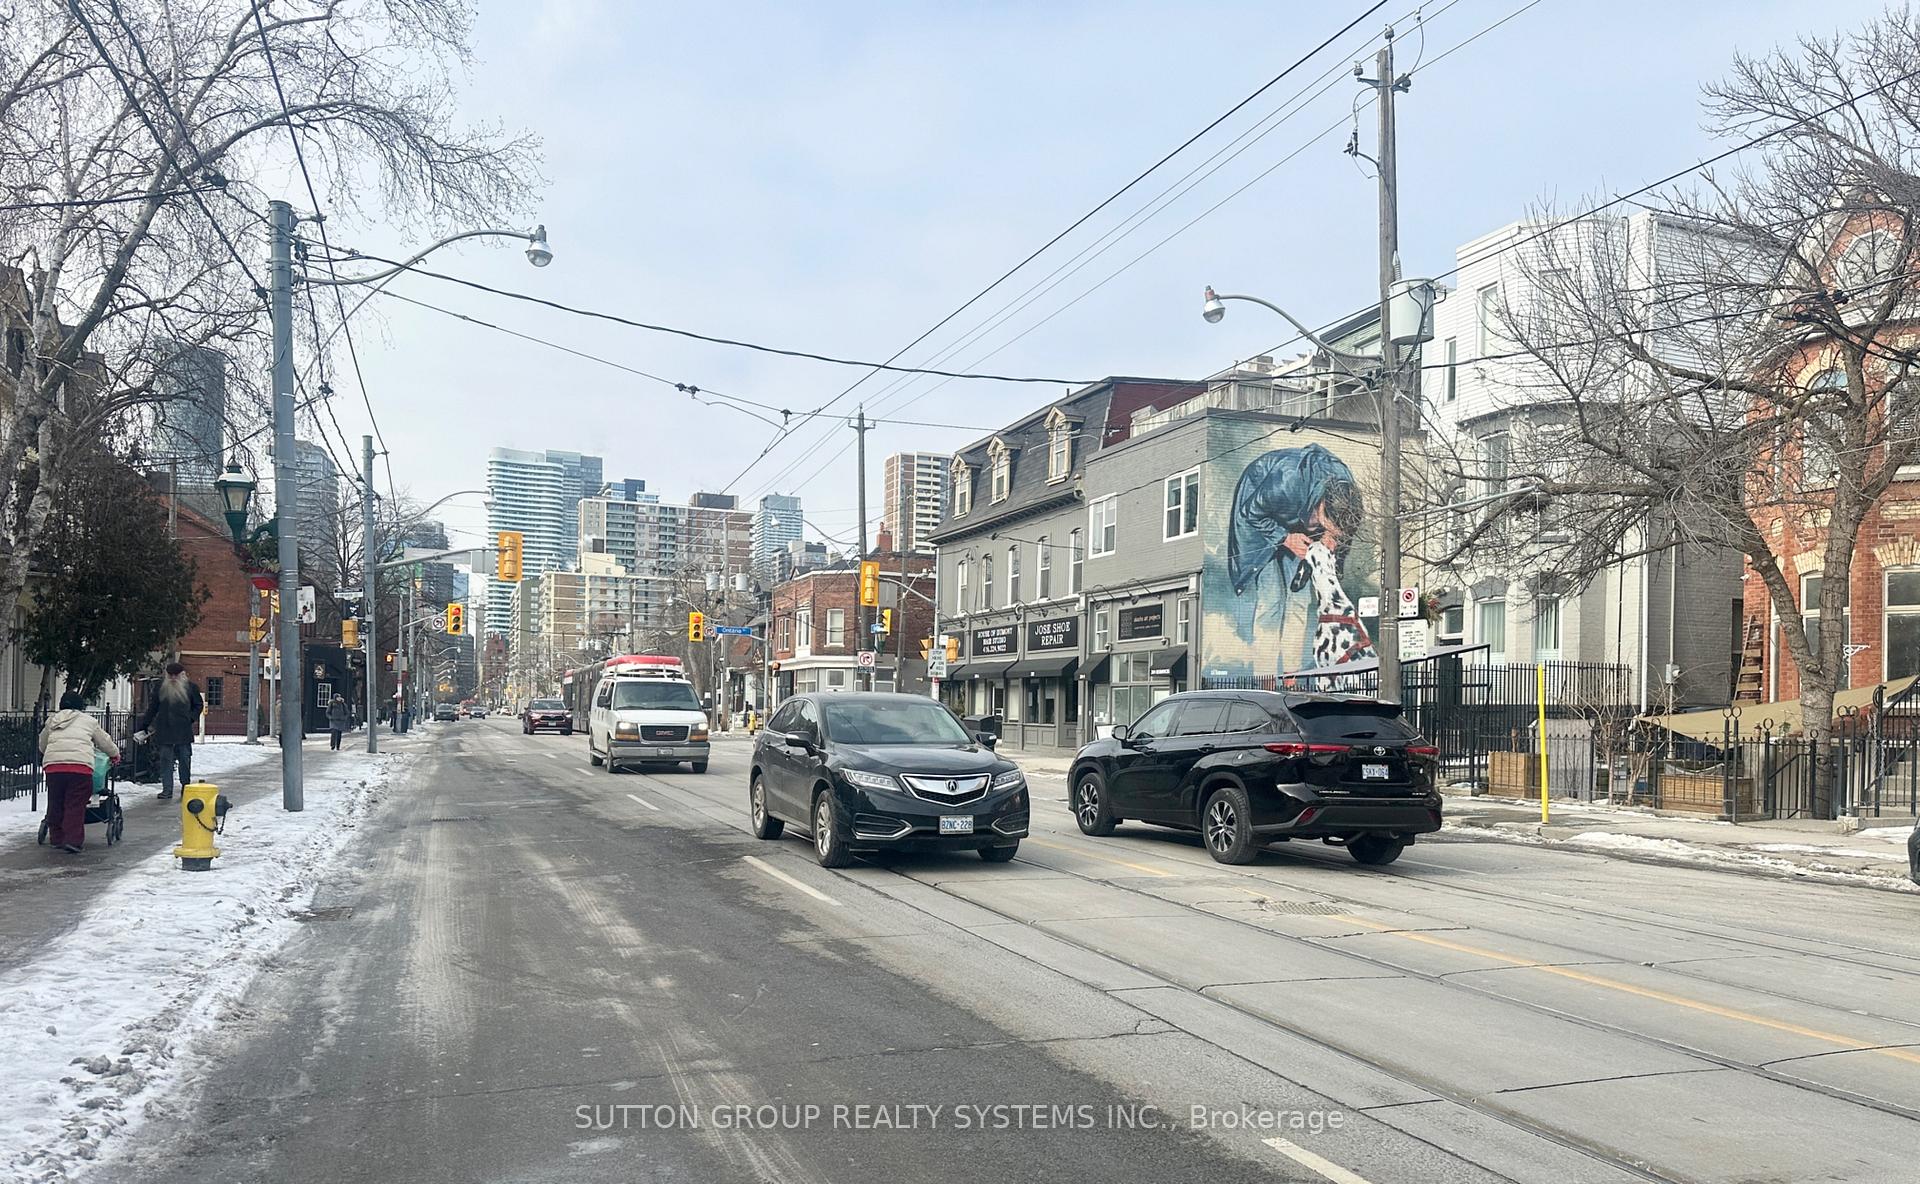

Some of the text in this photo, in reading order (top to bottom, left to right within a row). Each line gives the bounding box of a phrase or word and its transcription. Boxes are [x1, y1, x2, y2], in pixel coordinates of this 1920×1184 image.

[722, 626, 742, 634] Ontario
[1034, 621, 1071, 635] JOSE SHOE
[1041, 633, 1064, 646] REPAIR
